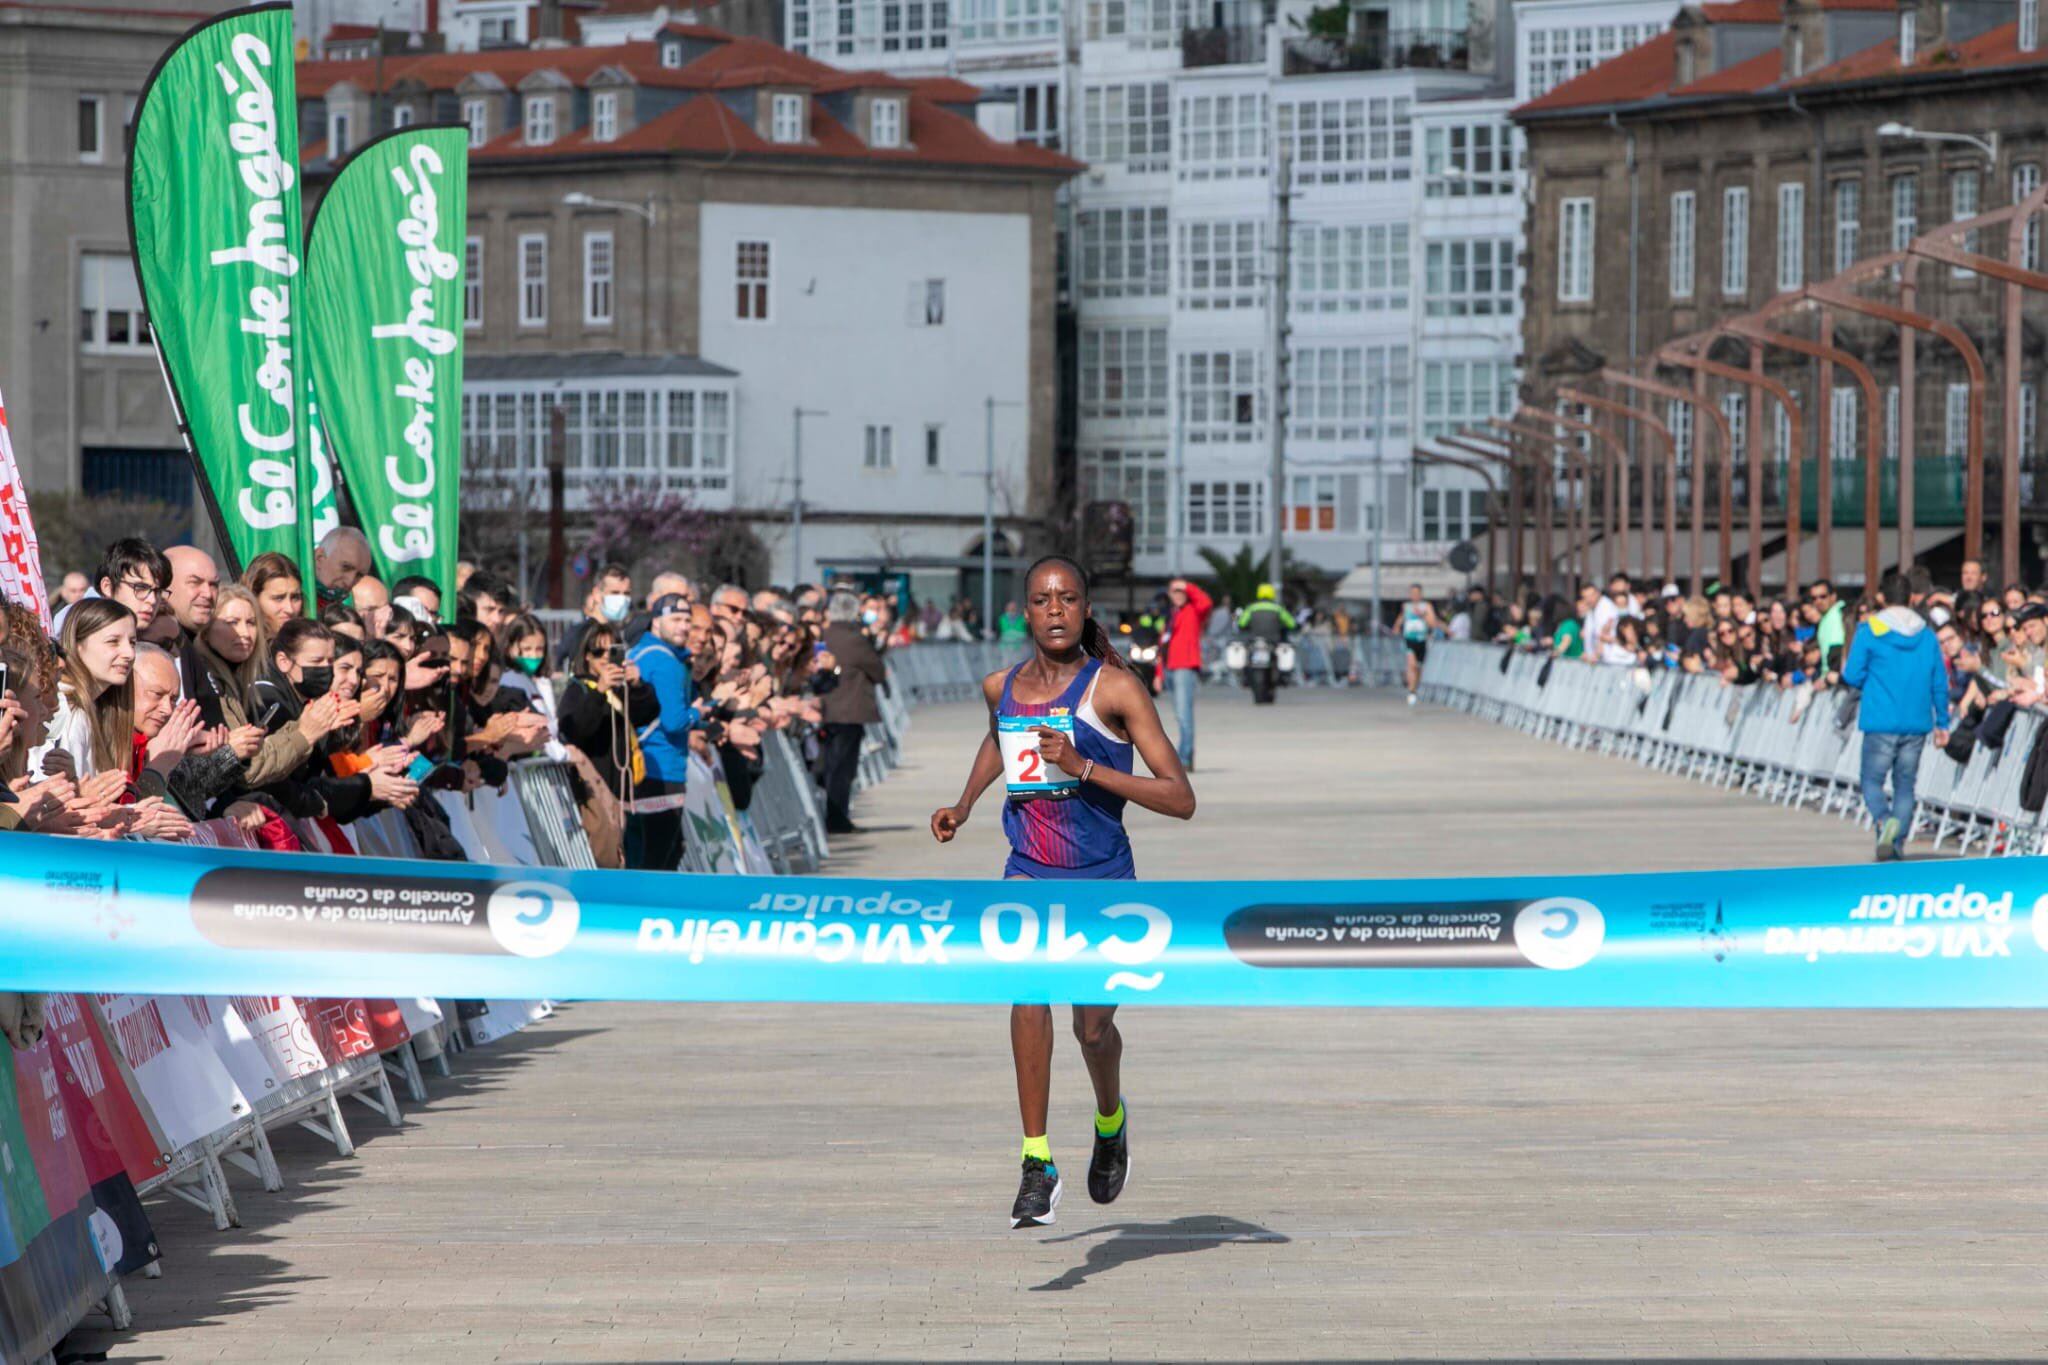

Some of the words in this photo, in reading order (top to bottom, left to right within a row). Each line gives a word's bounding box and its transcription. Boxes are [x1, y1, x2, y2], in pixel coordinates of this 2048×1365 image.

[211, 33, 299, 276] Inglés
[372, 144, 459, 355] Inglés
[238, 284, 295, 451] Corte
[385, 358, 435, 497] Corte
[239, 456, 297, 529] El
[379, 503, 435, 562] El
[1018, 749, 1041, 782] 2
[304, 886, 369, 901] Coruña
[373, 888, 395, 902] da
[400, 889, 475, 905] Concello
[233, 904, 298, 920] Coruña
[303, 906, 317, 921] A
[749, 891, 952, 921] Popular
[1849, 884, 2013, 924] Popular
[322, 906, 342, 923] de
[347, 906, 475, 925] Ayuntamiento
[1334, 913, 1397, 926] Coruña
[1402, 913, 1420, 926] da
[1422, 912, 1501, 925] Concello
[636, 917, 856, 964] Carreira
[1265, 926, 1328, 941] Coruña
[1332, 927, 1345, 941] A
[1350, 926, 1372, 941] de
[1377, 924, 1501, 941] Ayuntamiento
[1941, 925, 2014, 957] XVI
[862, 921, 954, 964] XVI
[1763, 925, 1936, 962] Carreira
